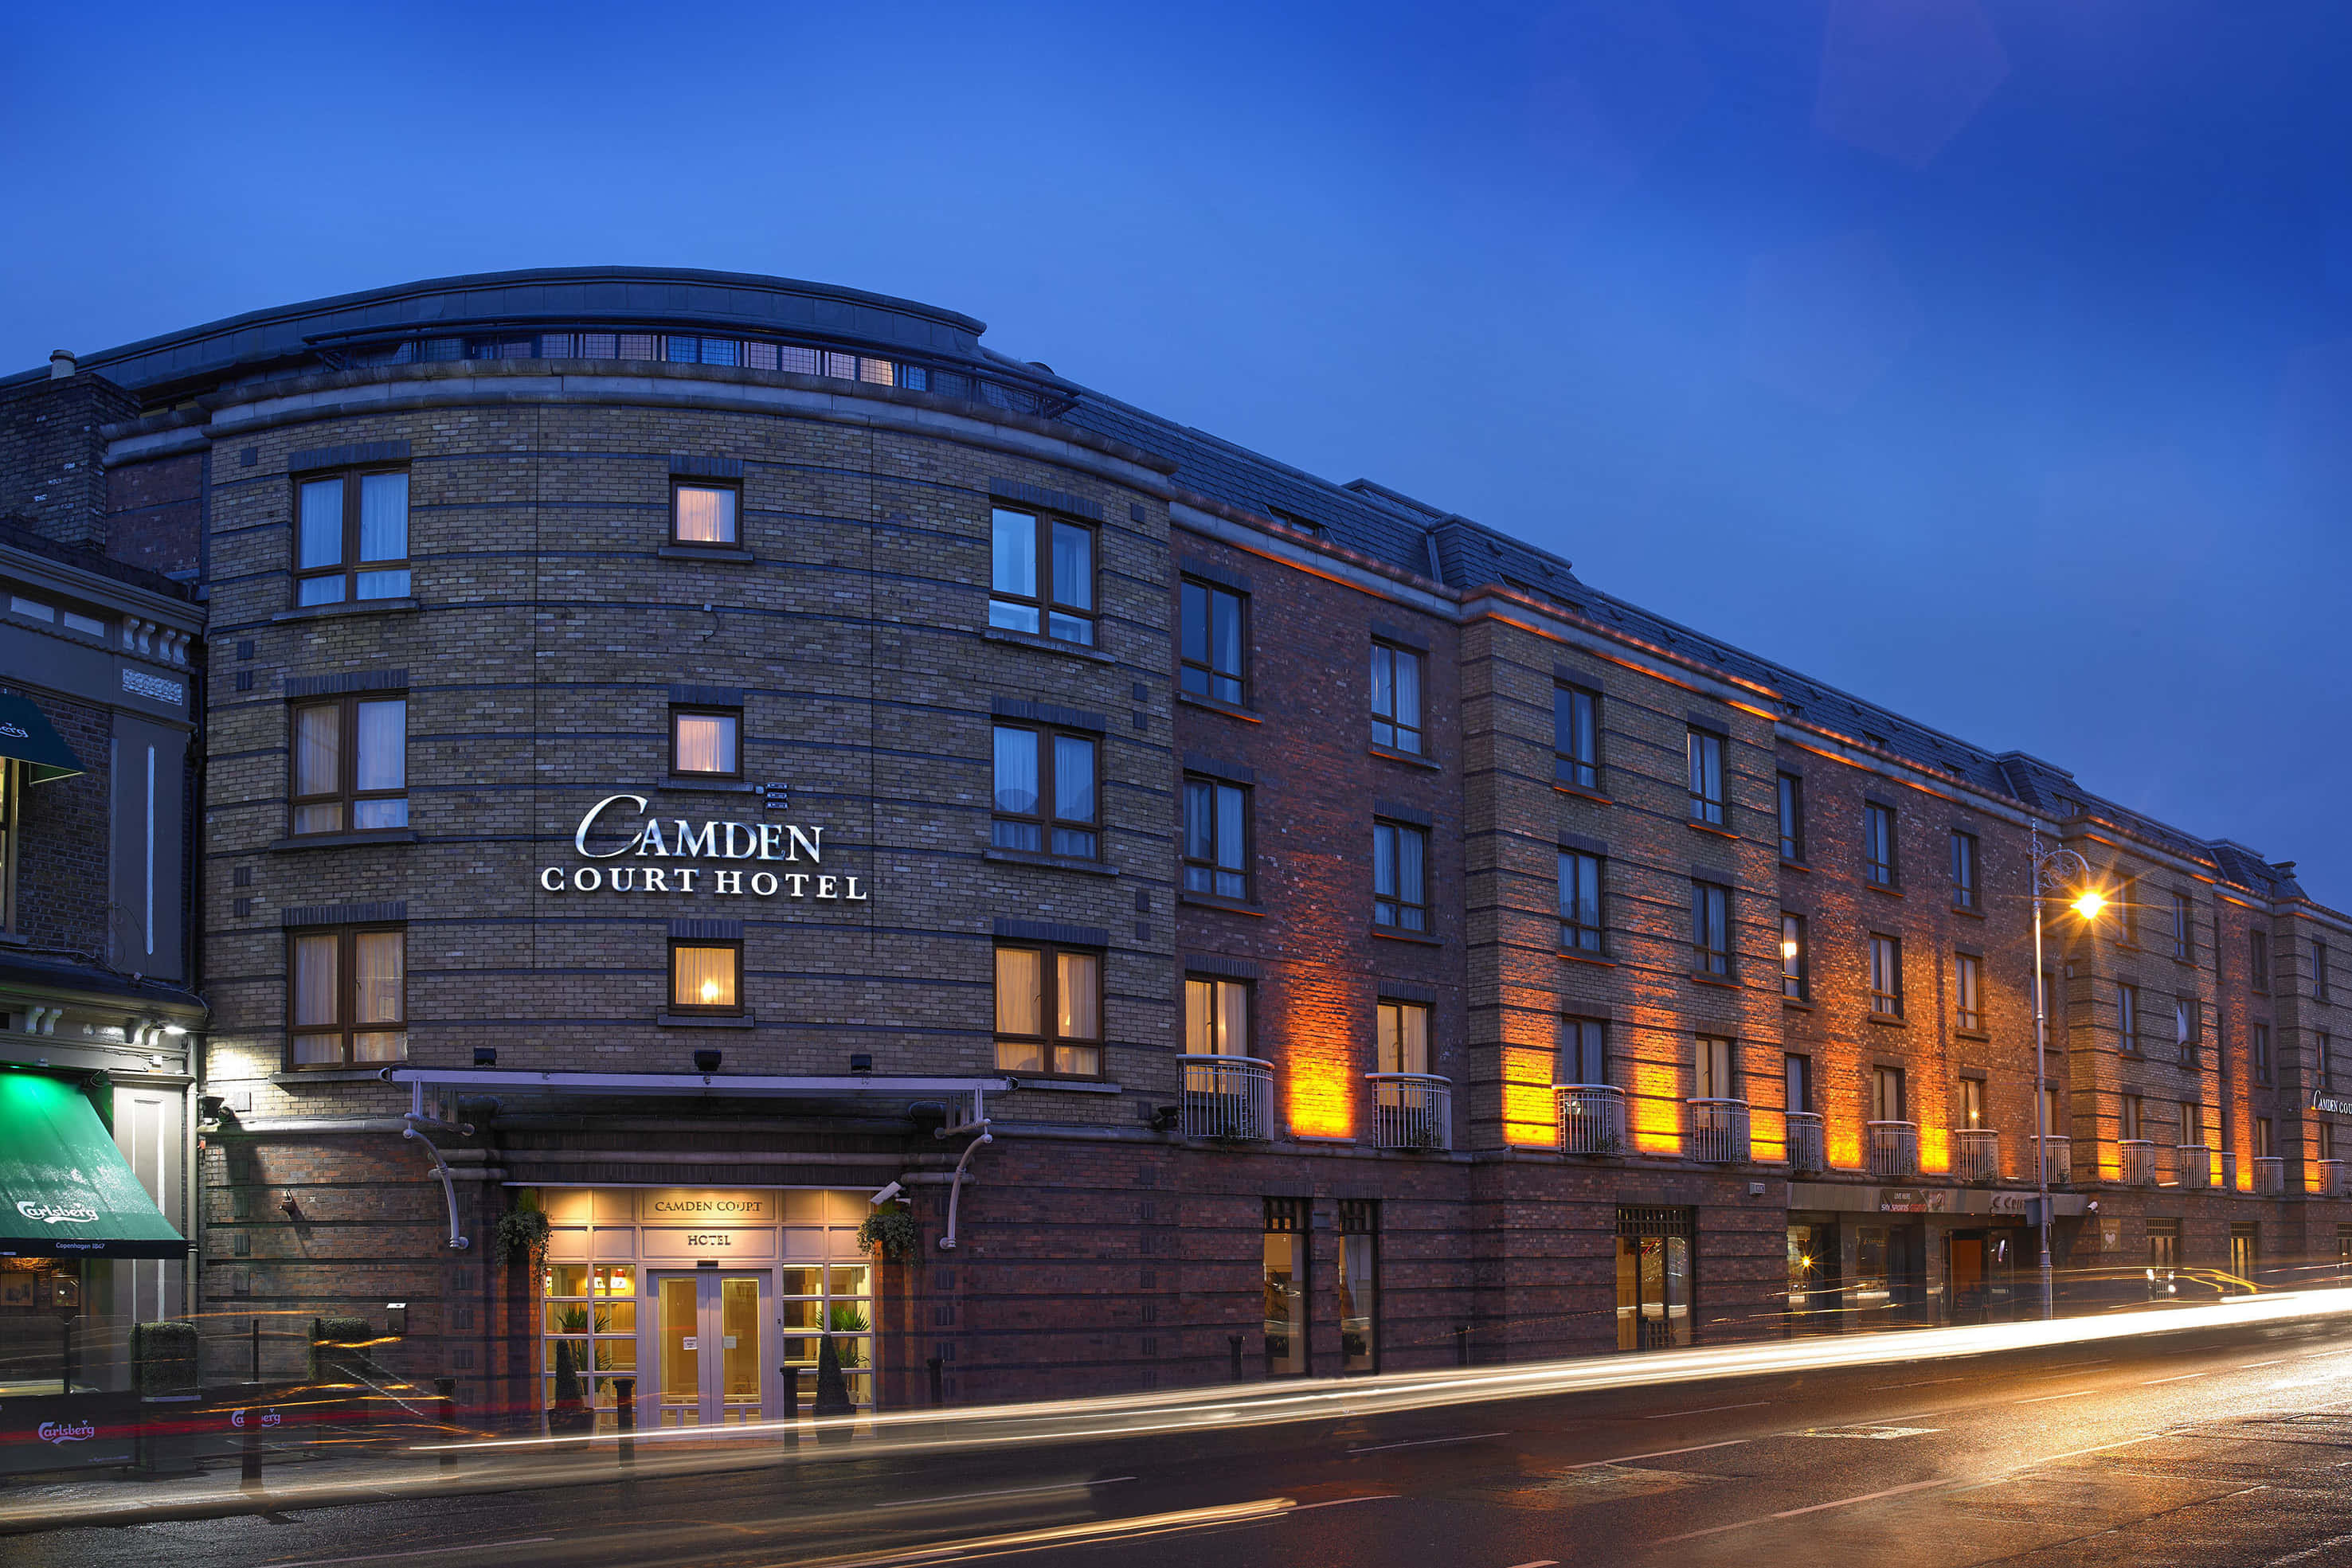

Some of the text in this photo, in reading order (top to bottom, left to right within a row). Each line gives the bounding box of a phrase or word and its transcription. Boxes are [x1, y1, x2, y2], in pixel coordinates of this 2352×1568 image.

[575, 794, 825, 864] CAMDEN
[540, 866, 868, 901] COURT HOTEL
[2313, 1089, 2352, 1115] CAMDEN COU
[17, 1201, 100, 1224] Carlsberg
[655, 1201, 763, 1212] CAMDEN COURT
[687, 1235, 731, 1245] HOTEL
[231, 1408, 281, 1427] Caerg
[37, 1420, 95, 1445] Carlsberg
